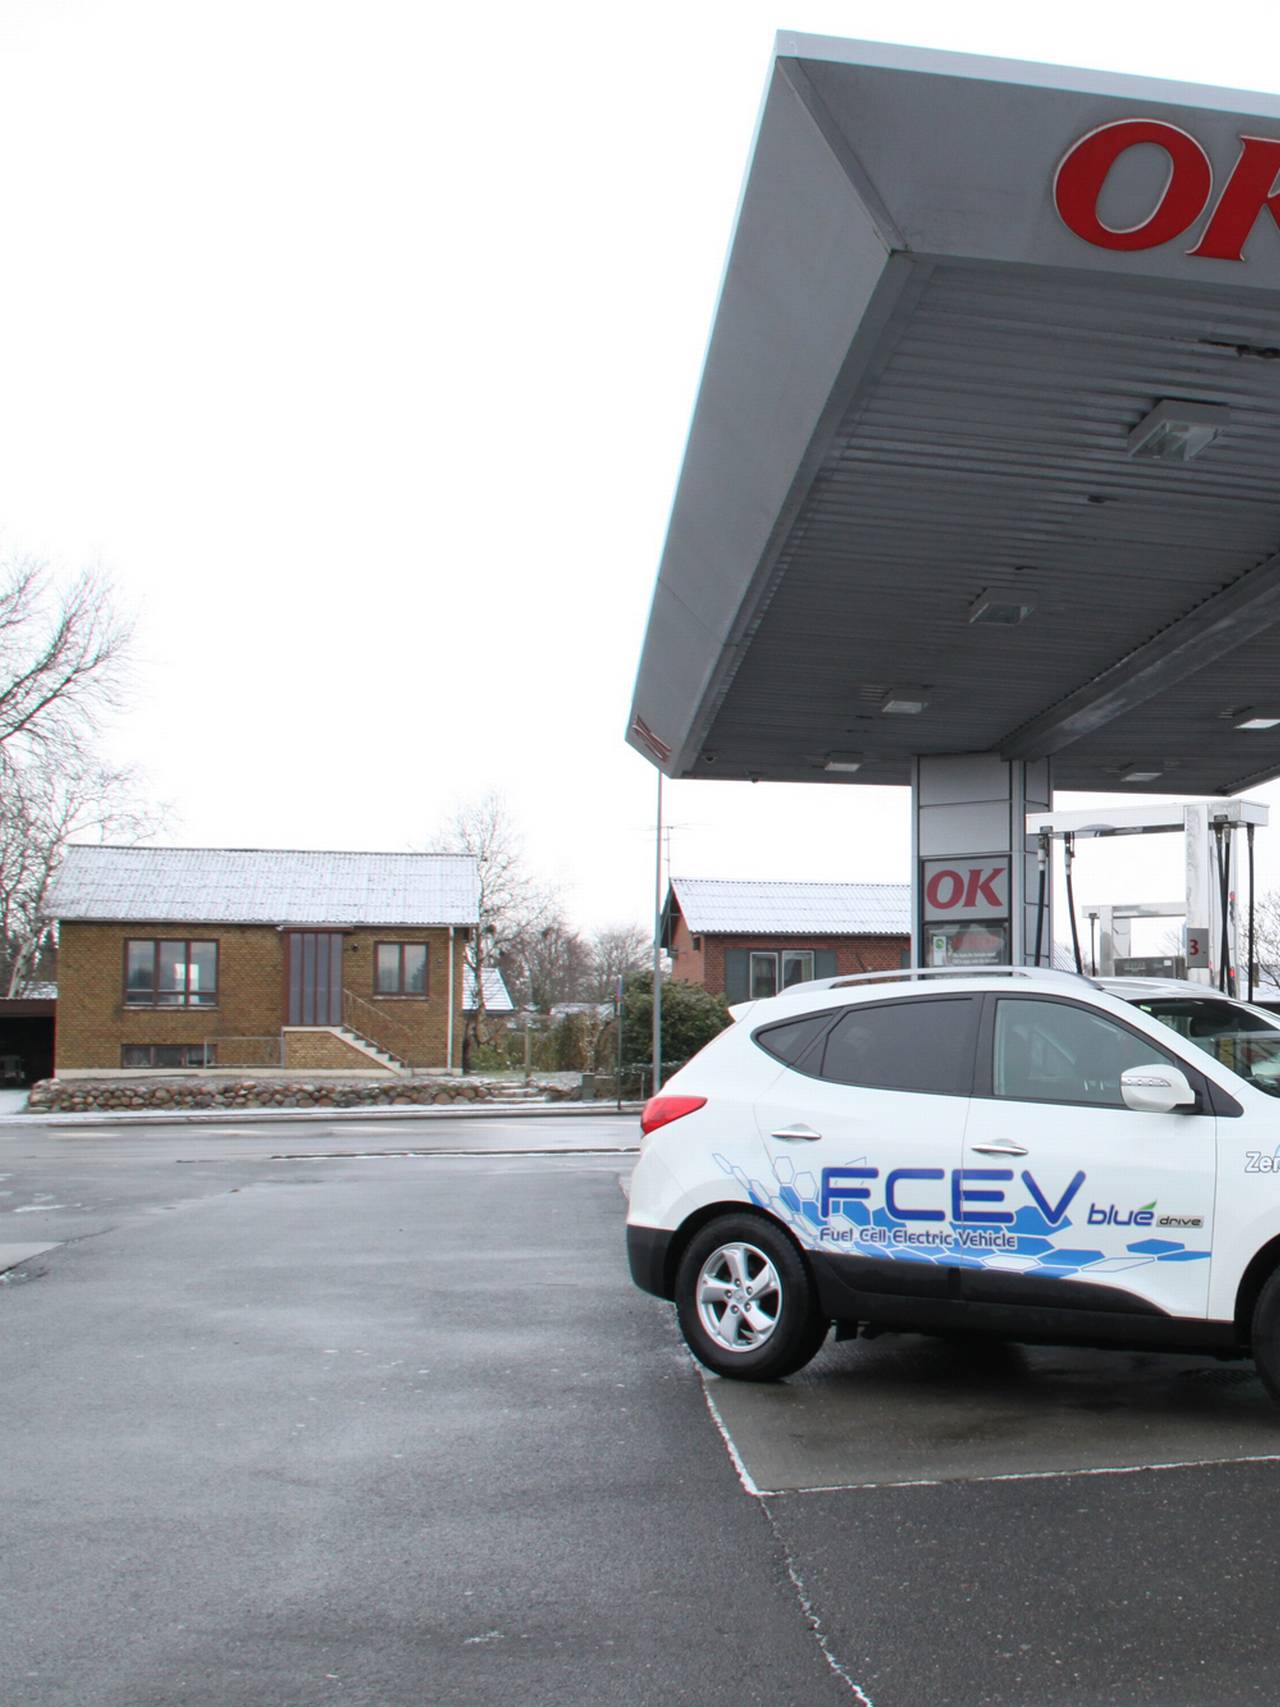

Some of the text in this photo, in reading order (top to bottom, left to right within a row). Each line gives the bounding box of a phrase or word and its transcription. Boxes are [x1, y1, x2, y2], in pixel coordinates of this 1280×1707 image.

[926, 867, 1006, 910] OK
[1189, 939, 1200, 956] 3
[819, 1167, 1086, 1224] FCEV
[1087, 1201, 1201, 1227] blue drive
[819, 1227, 1016, 1248] Fuel Cell Electric Vehicle
